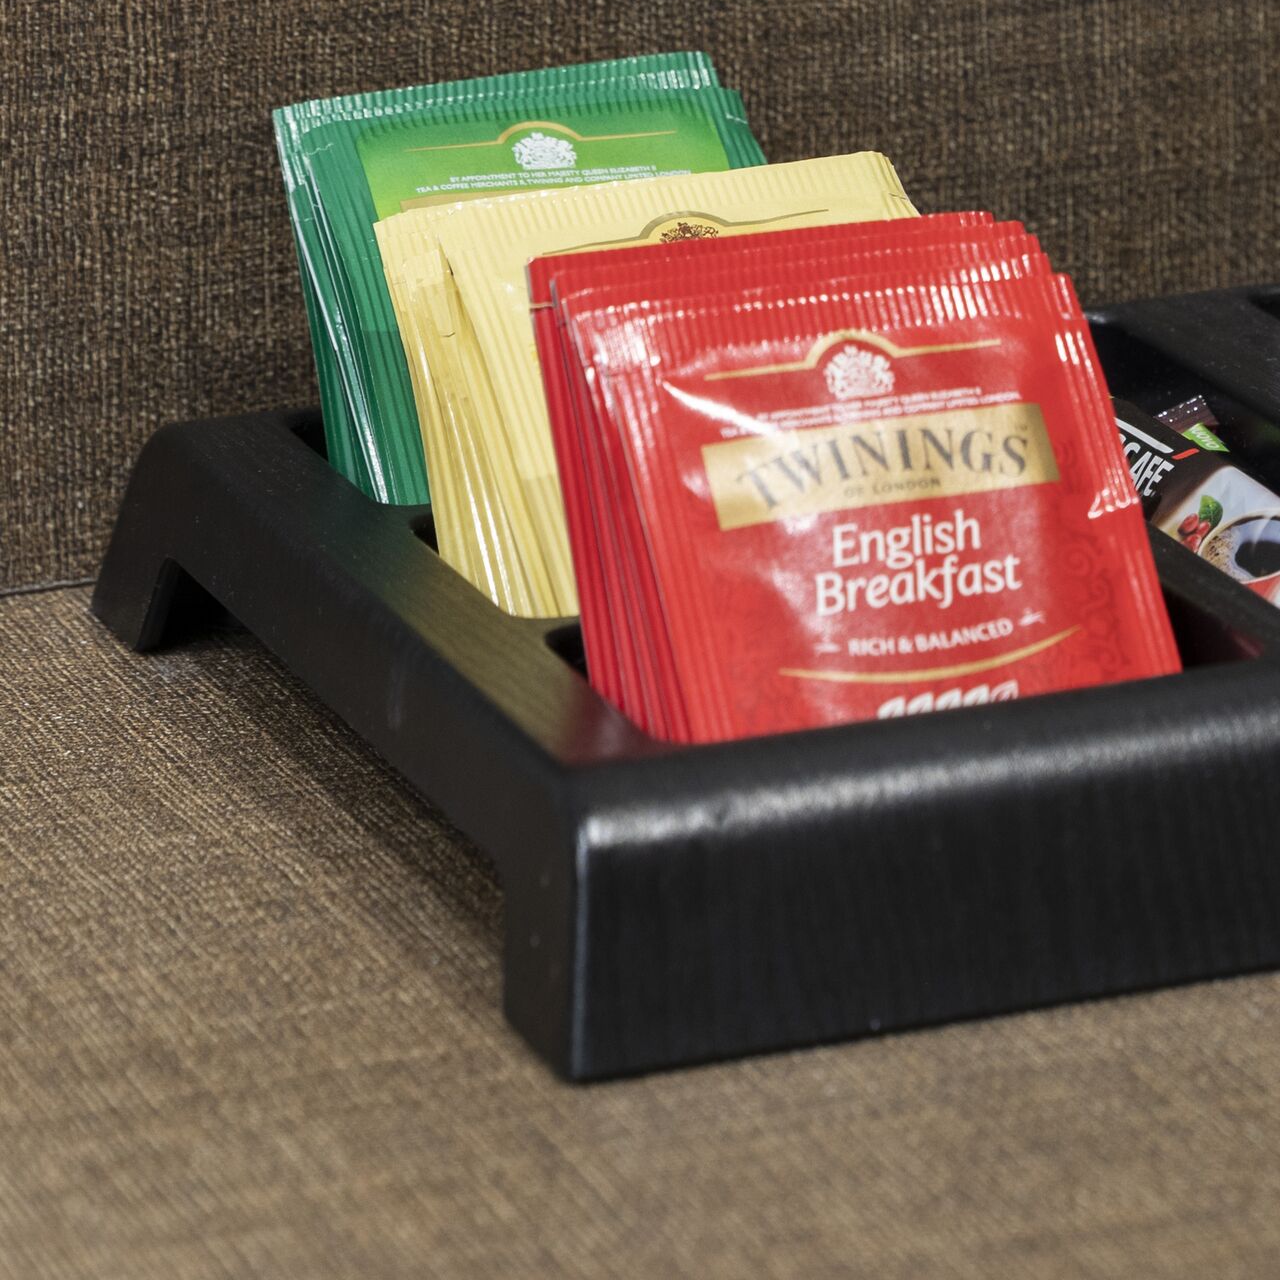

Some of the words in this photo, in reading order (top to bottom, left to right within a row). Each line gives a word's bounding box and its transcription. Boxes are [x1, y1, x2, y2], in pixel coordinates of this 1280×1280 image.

[737, 426, 1029, 512] TWININGS
[872, 477, 942, 495] LONDON
[832, 508, 983, 570] English
[815, 554, 1023, 618] Breakfast
[848, 635, 896, 657] RICH
[897, 634, 914, 654] &
[914, 617, 1014, 653] BALANCED
